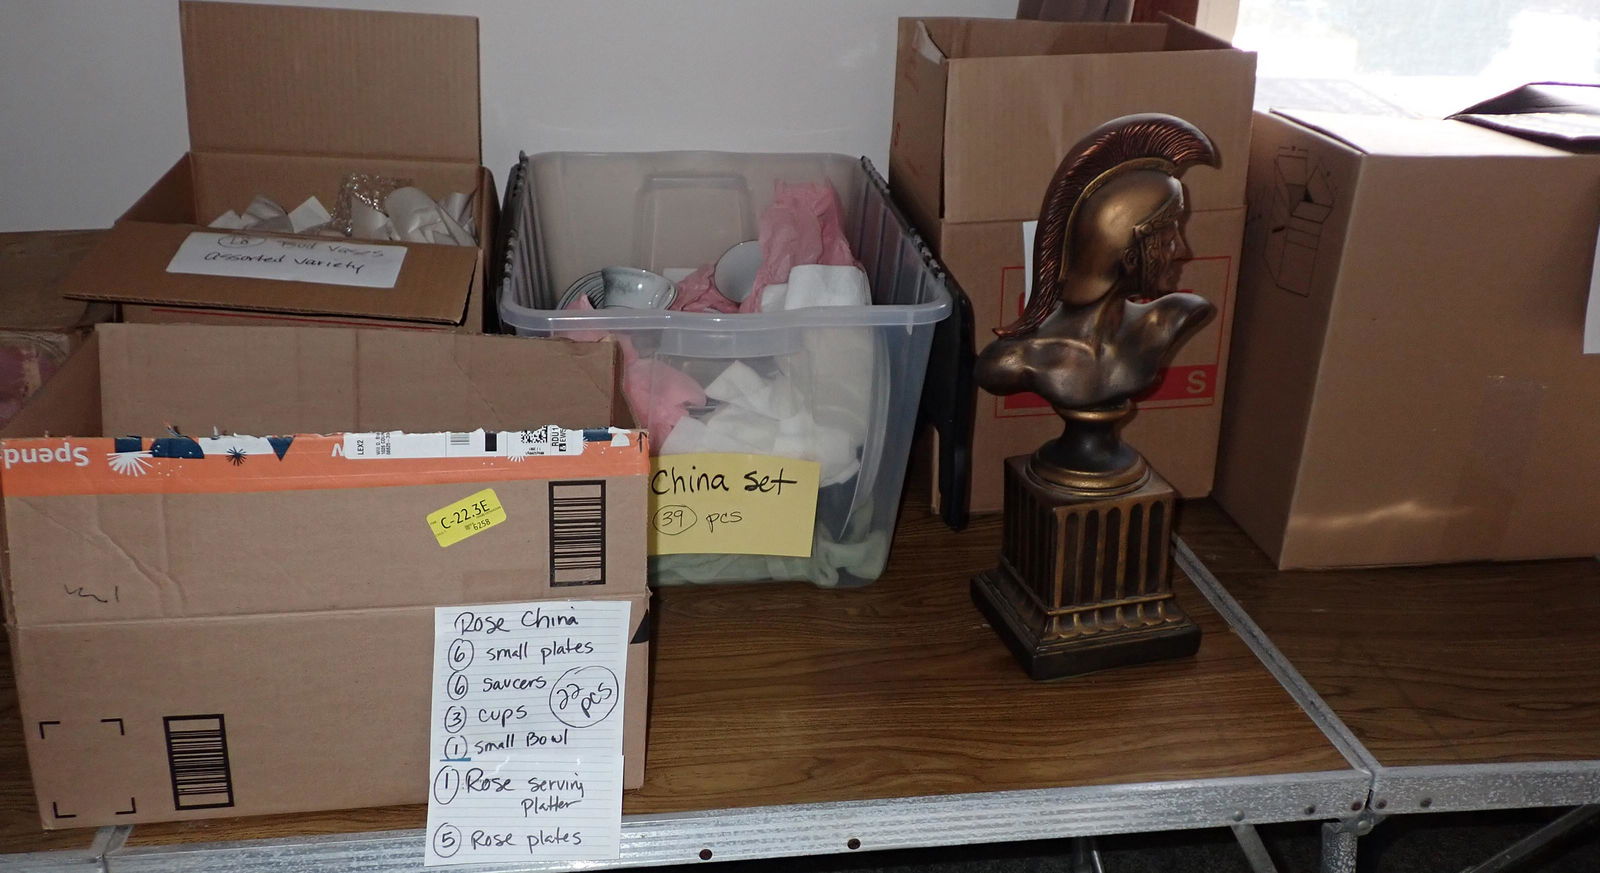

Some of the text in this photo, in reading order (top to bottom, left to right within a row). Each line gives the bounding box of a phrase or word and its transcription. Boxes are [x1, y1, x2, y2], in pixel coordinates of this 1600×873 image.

[356, 439, 365, 456] LEX2
[551, 427, 560, 447] RDU1
[3, 441, 90, 469] Spend
[651, 465, 798, 496] China set
[441, 500, 491, 529] C-22.3E
[705, 511, 743, 533] pcs
[454, 606, 579, 635] Rose China
[486, 642, 528, 661] small
[541, 638, 594, 665] plates
[482, 677, 547, 693] saucers
[478, 704, 528, 728] cups
[474, 733, 514, 755] small
[526, 728, 569, 748] Bowl
[465, 767, 516, 793] Rose
[471, 830, 519, 849] Rose
[527, 827, 582, 854] plates
